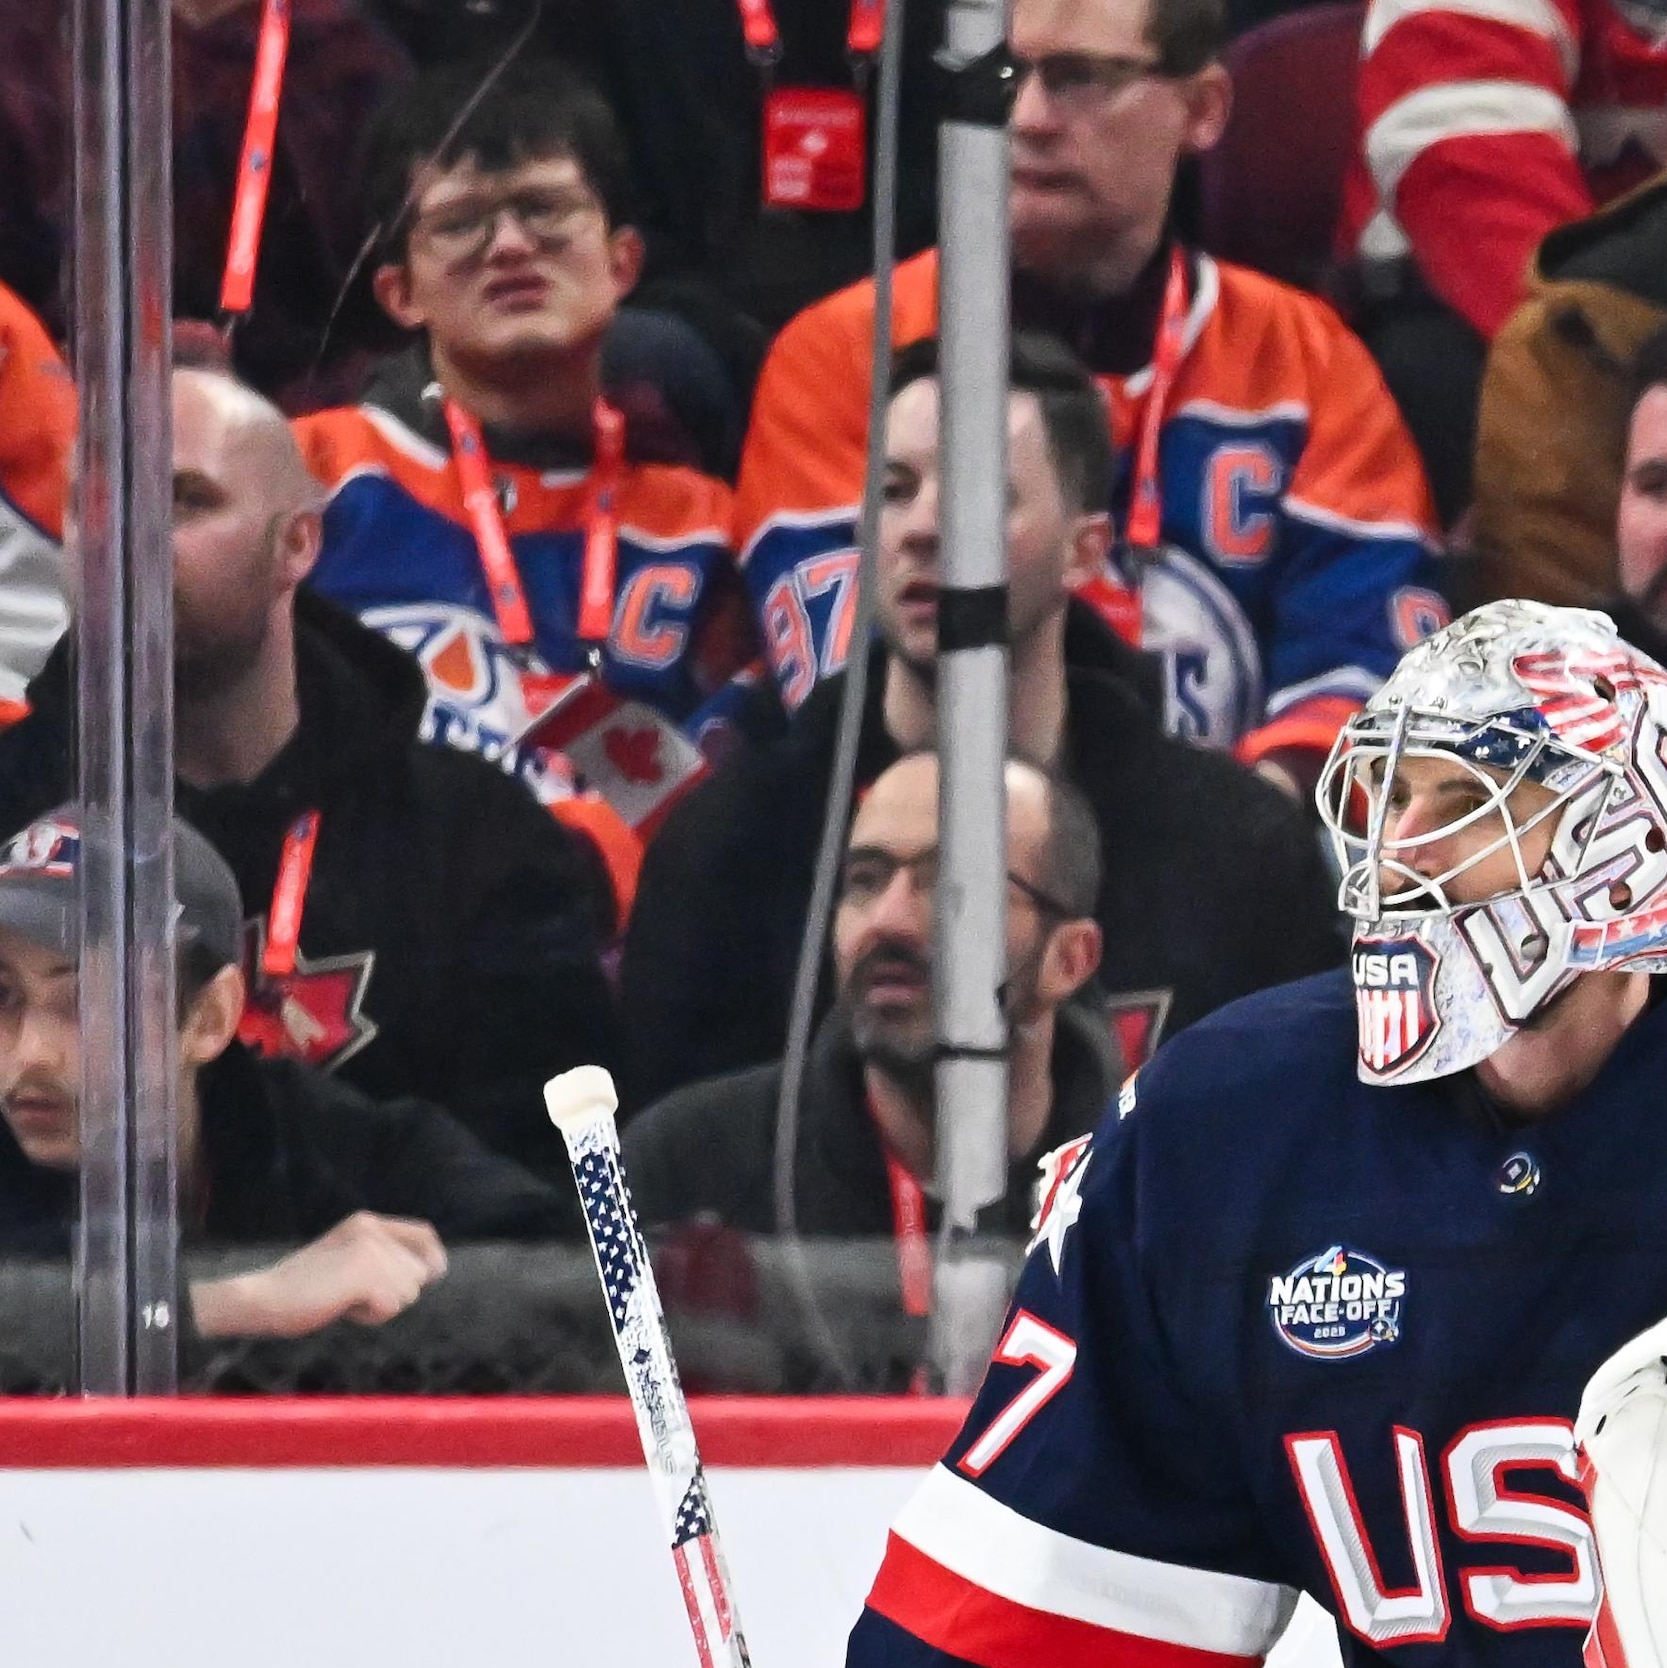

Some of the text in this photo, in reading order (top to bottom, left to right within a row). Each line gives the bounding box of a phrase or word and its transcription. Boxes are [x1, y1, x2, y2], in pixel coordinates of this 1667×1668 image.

[1200, 440, 1284, 567] C
[606, 562, 702, 670] C
[764, 546, 860, 713] 97
[1353, 953, 1418, 986] USA
[1270, 1271, 1405, 1305] NATIONS
[1281, 1299, 1393, 1325] FACE-OFF
[957, 1307, 1077, 1479] 7
[1284, 1416, 1603, 1648] US
